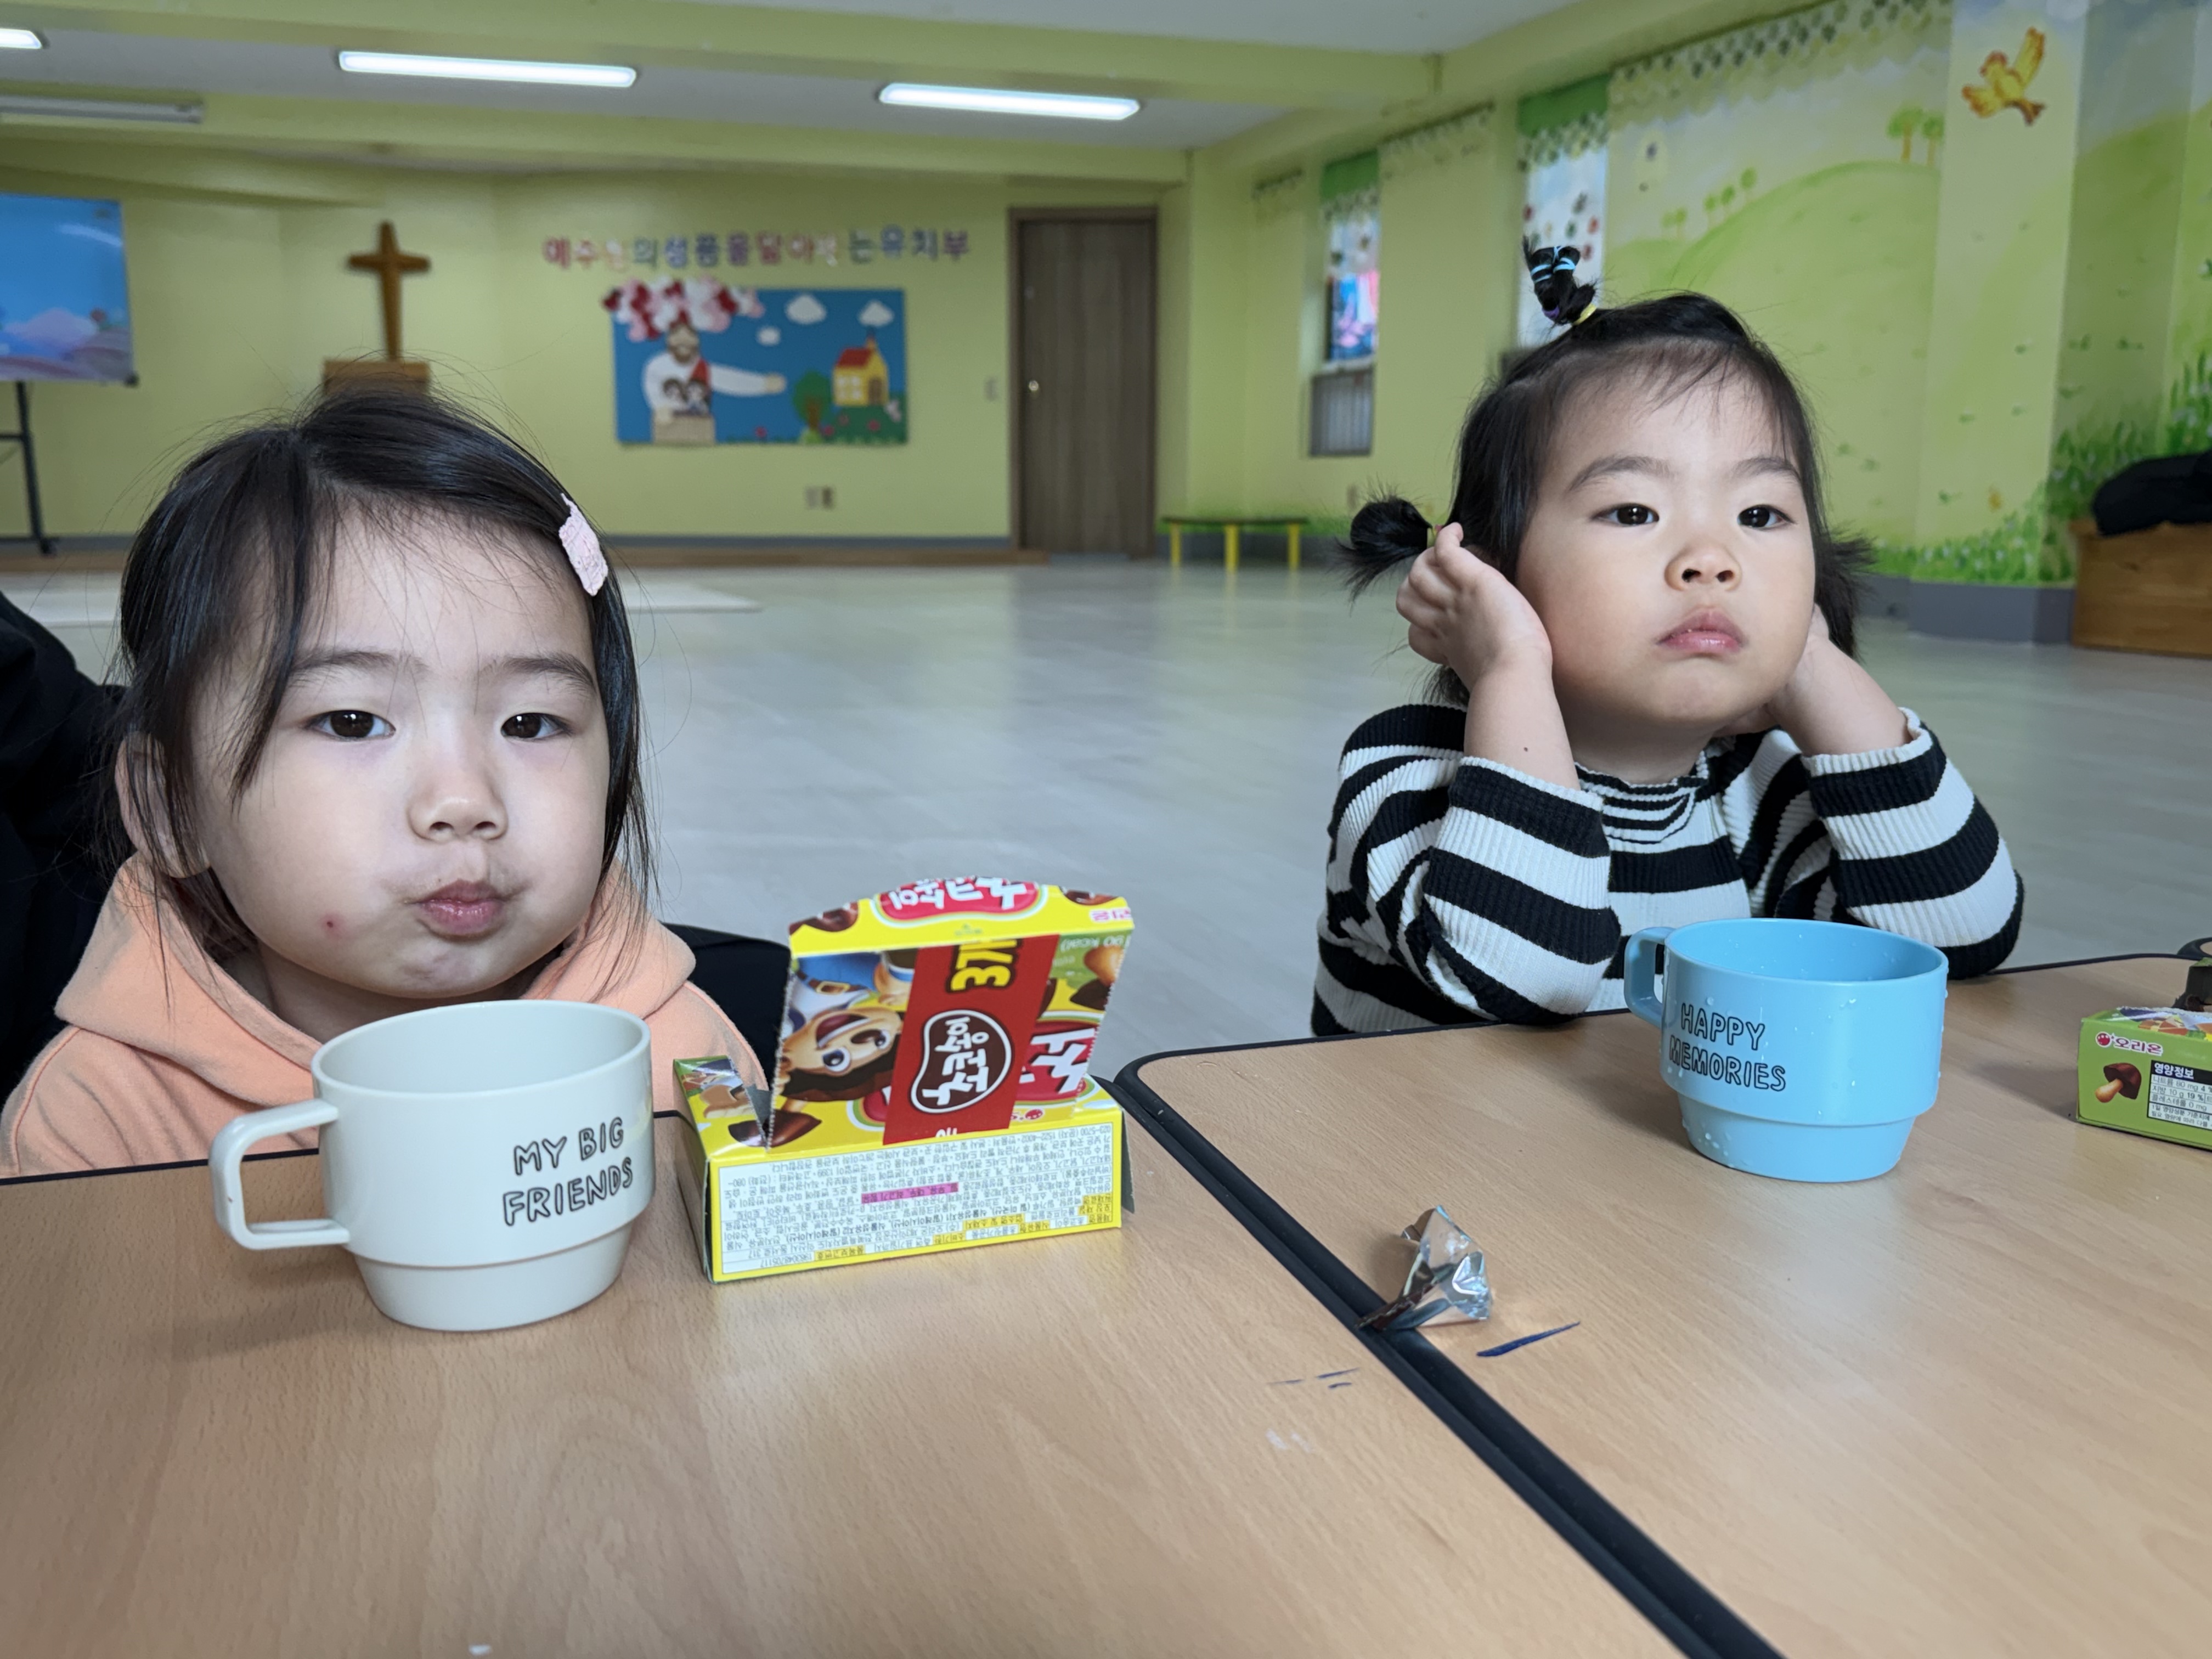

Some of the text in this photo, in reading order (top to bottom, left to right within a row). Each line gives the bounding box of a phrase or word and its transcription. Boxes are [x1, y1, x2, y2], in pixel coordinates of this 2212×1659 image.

[1680, 1002, 1765, 1051] HAPPY
[2114, 1037, 2163, 1056] 오리온
[922, 1016, 990, 1106] 초코송이
[1669, 1035, 1786, 1092] MEMORIES
[2154, 1062, 2194, 1080] 영양정보
[2152, 1086, 2166, 1095] 지방
[2187, 1084, 2199, 1092] mg
[2152, 1094, 2186, 1107] 콜레스테롤
[2196, 1104, 2207, 1113] mg
[1058, 1128, 1078, 1139] (문자)
[514, 1116, 624, 1176] MY BIG
[970, 1139, 985, 1149] 본사
[1069, 1136, 1084, 1148] 곳에
[1086, 1134, 1101, 1146] 낮은
[902, 1147, 918, 1158] 보관
[934, 1142, 957, 1154] 구입한
[980, 1147, 995, 1158] 빨리
[997, 1144, 1020, 1156] 가급적
[1032, 1141, 1047, 1152] 개봉
[877, 1149, 900, 1161] 시에는
[1010, 1152, 1040, 1164] 무해하니
[1042, 1149, 1064, 1160] 인체에
[816, 1156, 839, 1168] 보관을
[985, 1156, 1007, 1167] 드셔도
[836, 1163, 867, 1176] 국번없이
[747, 1174, 771, 1186] (전화)
[860, 1172, 876, 1183] 의한
[503, 1156, 633, 1227] FRIENDS
[759, 1184, 776, 1195] 피해
[779, 1179, 819, 1193] 직사광선을
[832, 1185, 848, 1196] 온도
[786, 1190, 802, 1202] 따라
[805, 1187, 829, 1199] 변화에
[1082, 1192, 1110, 1204] 원재료명
[740, 1195, 764, 1207] 반점이
[1032, 1199, 1054, 1210] 밀가루
[1096, 1202, 1110, 1212] 포장
[1031, 1206, 1075, 1221] 폴리프로필렌
[945, 1221, 960, 1232] (주)
[1054, 1216, 1084, 1227] 초코송이
[921, 1223, 943, 1235] 오리온
[934, 1232, 963, 1244] 소비기한
[764, 1244, 787, 1256] 동서로
[790, 1240, 814, 1253] 익산시
[748, 1248, 760, 1259] 317
